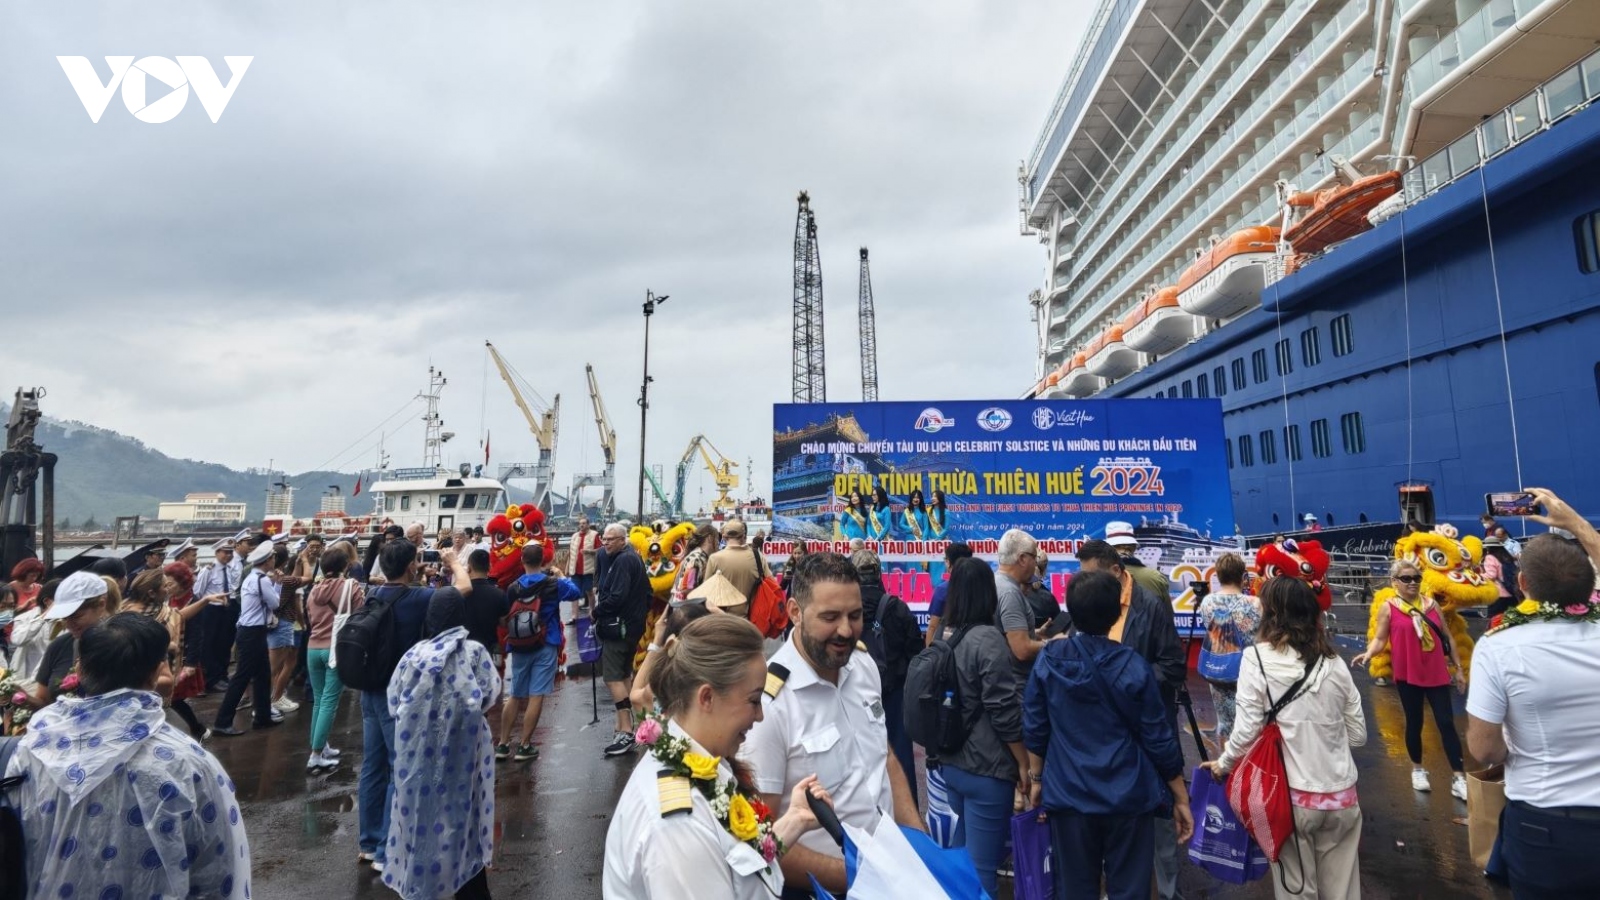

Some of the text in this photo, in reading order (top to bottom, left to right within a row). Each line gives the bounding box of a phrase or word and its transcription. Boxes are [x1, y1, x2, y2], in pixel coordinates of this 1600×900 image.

[800, 441, 825, 454] CHÀO
[828, 440, 856, 454] MỪNG
[857, 439, 894, 453] CHUYẾN
[896, 440, 914, 453] TÀU
[916, 441, 929, 453] DU
[931, 441, 952, 454] LỊCH
[954, 440, 1003, 453] CELEBRITY
[1005, 440, 1050, 452] SOLSTICE
[1052, 438, 1065, 452] VÀ
[1118, 438, 1151, 452] KHÁCH
[1174, 438, 1197, 452] TIÊN
[928, 467, 978, 495] THỪA
[983, 467, 1040, 495] THIÊN
[1046, 465, 1085, 495] HUẾ
[1090, 466, 1165, 496] 2024
[1343, 538, 1396, 555] Celebrity
